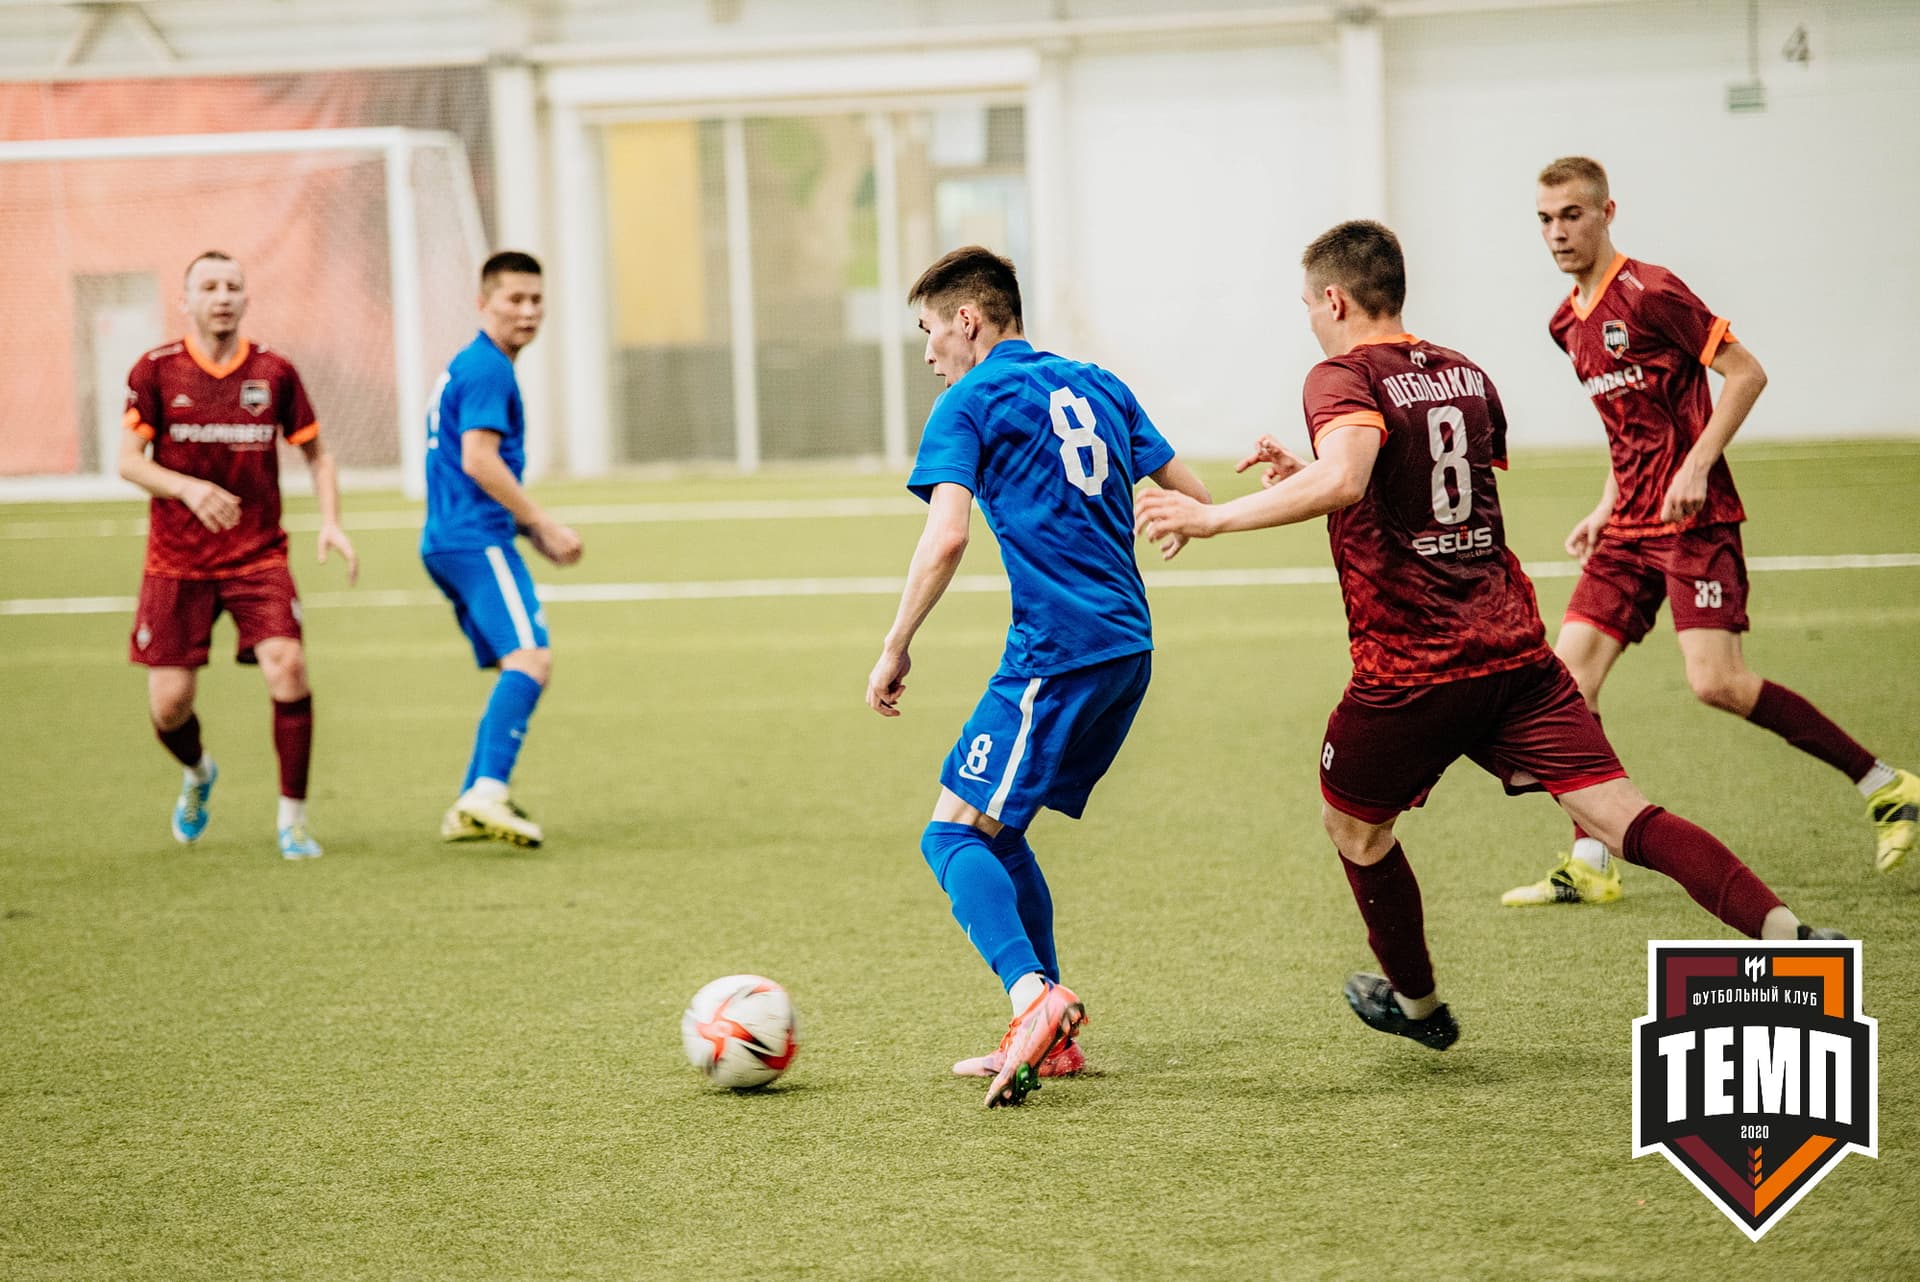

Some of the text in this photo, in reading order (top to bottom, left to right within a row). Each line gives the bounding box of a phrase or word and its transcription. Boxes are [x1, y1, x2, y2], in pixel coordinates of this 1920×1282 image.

[1049, 386, 1109, 496] 8
[1427, 405, 1472, 524] 8
[1695, 580, 1722, 608] 33
[967, 734, 992, 774] 8
[1322, 742, 1335, 770] 8
